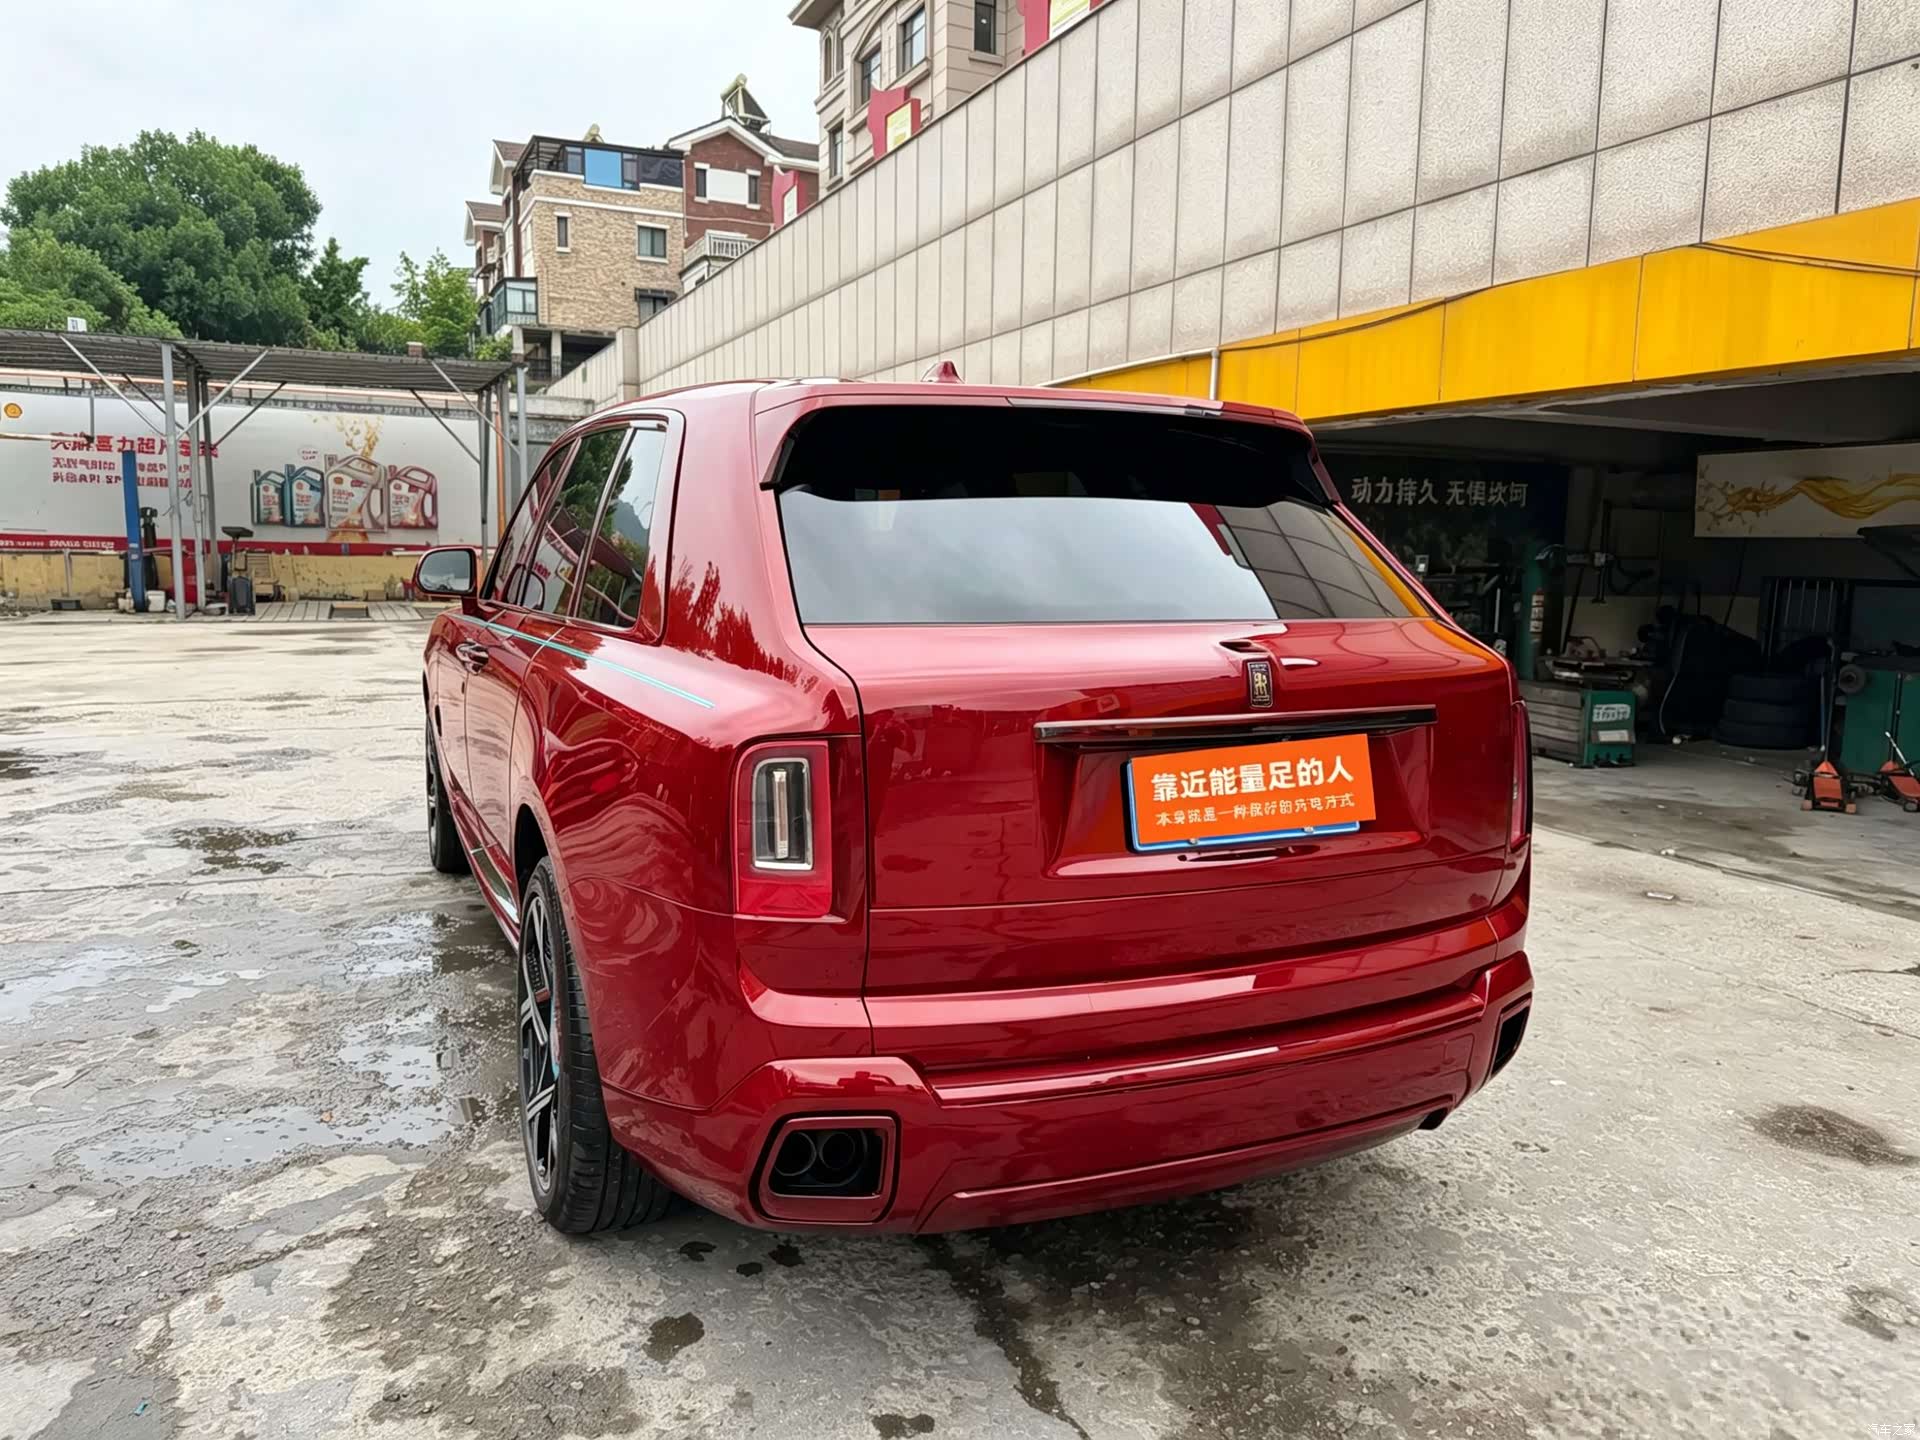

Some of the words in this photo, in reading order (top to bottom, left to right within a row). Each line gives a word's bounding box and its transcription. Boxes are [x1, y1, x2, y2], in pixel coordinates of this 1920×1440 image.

[1351, 476, 1439, 506] 动力持久
[1445, 480, 1529, 508] 无惧坎坷
[1150, 755, 1354, 802] 靠近能量足的人
